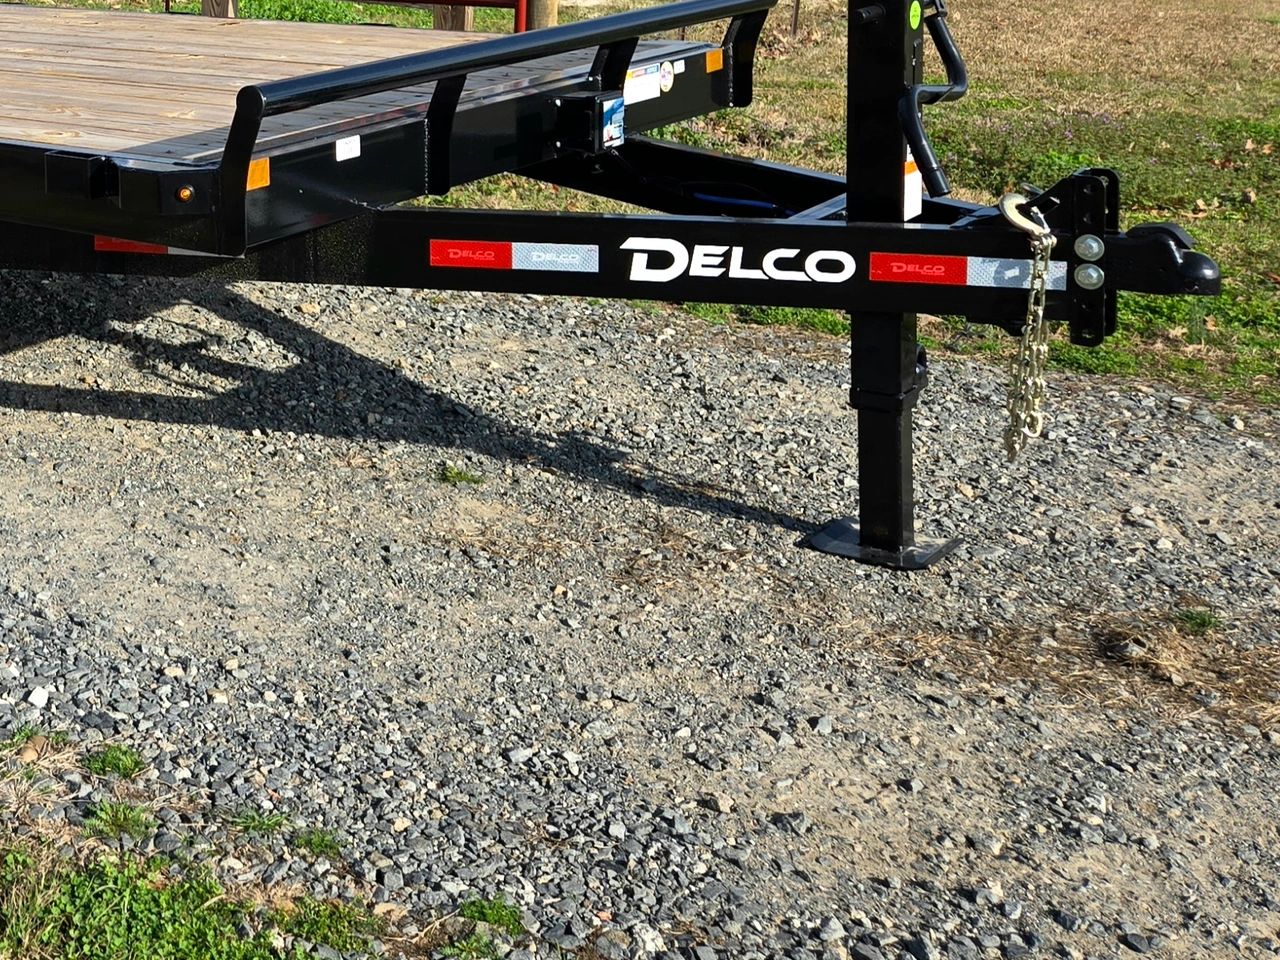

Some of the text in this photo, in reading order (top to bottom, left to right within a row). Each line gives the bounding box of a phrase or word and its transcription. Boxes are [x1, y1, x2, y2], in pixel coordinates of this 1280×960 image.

[447, 248, 495, 259] DELCO
[620, 236, 856, 283] DELCO
[890, 262, 945, 273] DELCO
